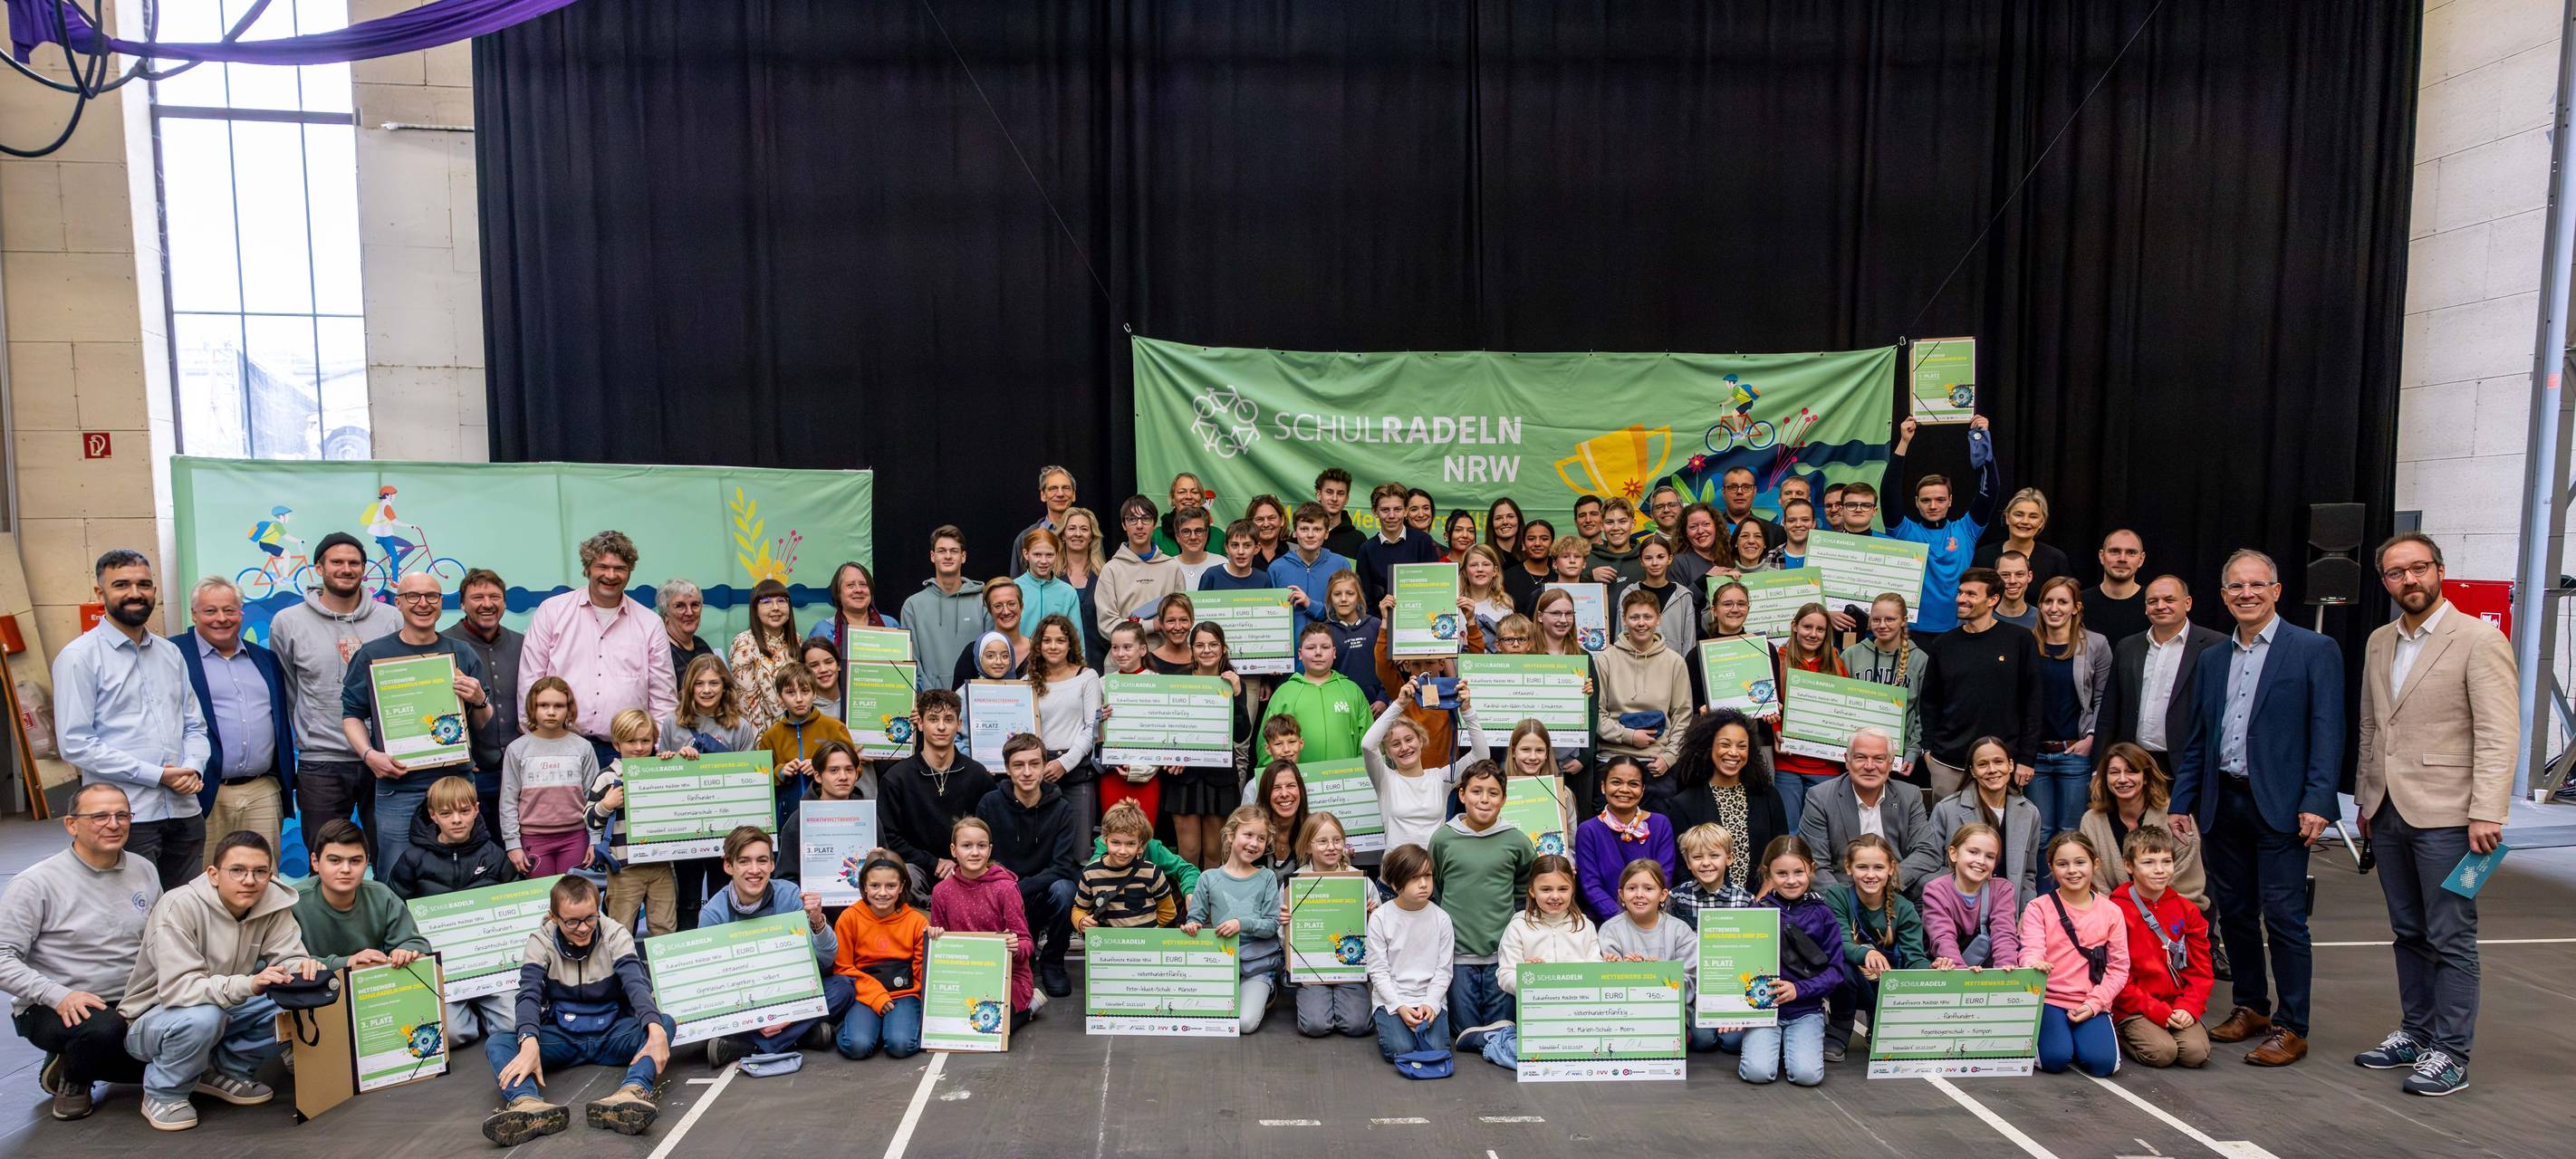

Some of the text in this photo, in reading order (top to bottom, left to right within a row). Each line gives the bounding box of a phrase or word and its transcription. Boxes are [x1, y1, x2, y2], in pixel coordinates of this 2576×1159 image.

[1274, 412, 1522, 445] SCHULRADELN
[1443, 455, 1521, 483] NRW
[392, 705, 415, 714] PLATZ
[641, 764, 684, 773] SCHULRADELN
[429, 899, 475, 913] SCHULRADELN
[498, 908, 516, 916] EURO
[666, 936, 712, 950] SCHULRADELN
[736, 946, 755, 955] EURO
[1536, 972, 1583, 981] SCHULRADELN
[370, 1016, 394, 1027] PLATZ
